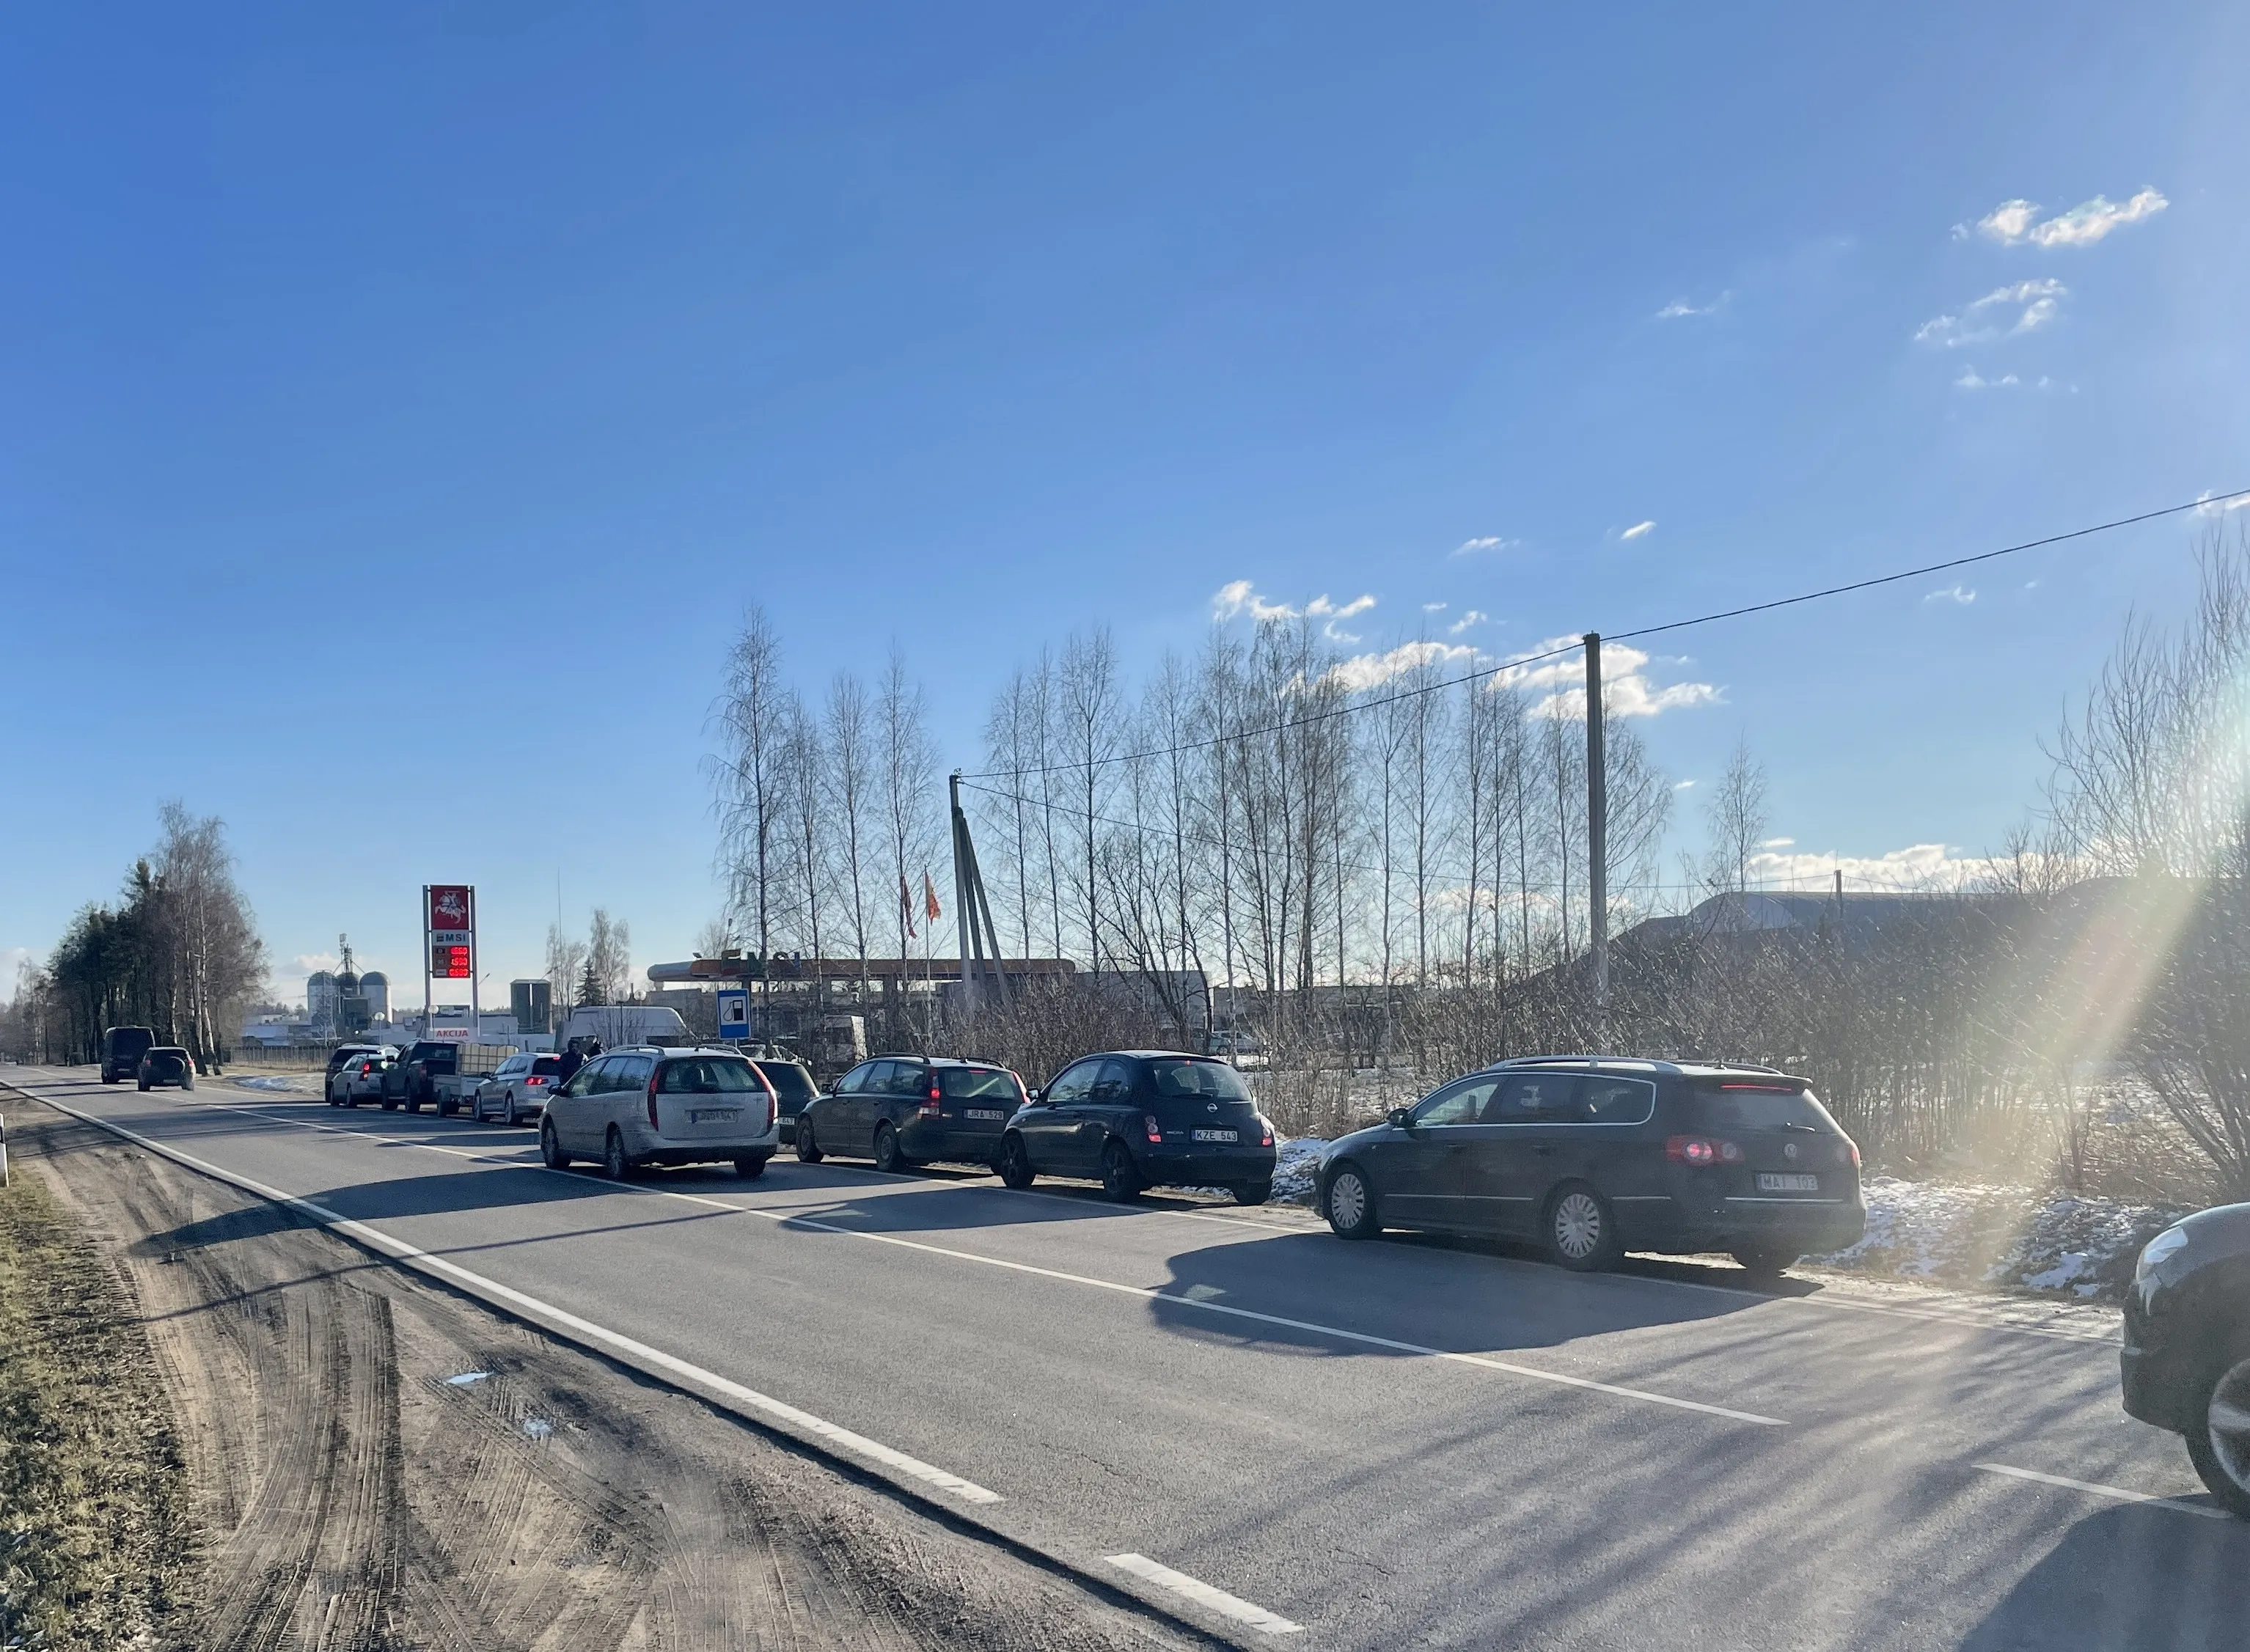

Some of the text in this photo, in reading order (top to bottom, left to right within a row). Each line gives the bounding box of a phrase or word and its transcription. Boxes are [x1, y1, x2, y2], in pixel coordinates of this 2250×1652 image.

[969, 1110, 1003, 1120] JRA 529
[1196, 1131, 1236, 1141] KZE 543
